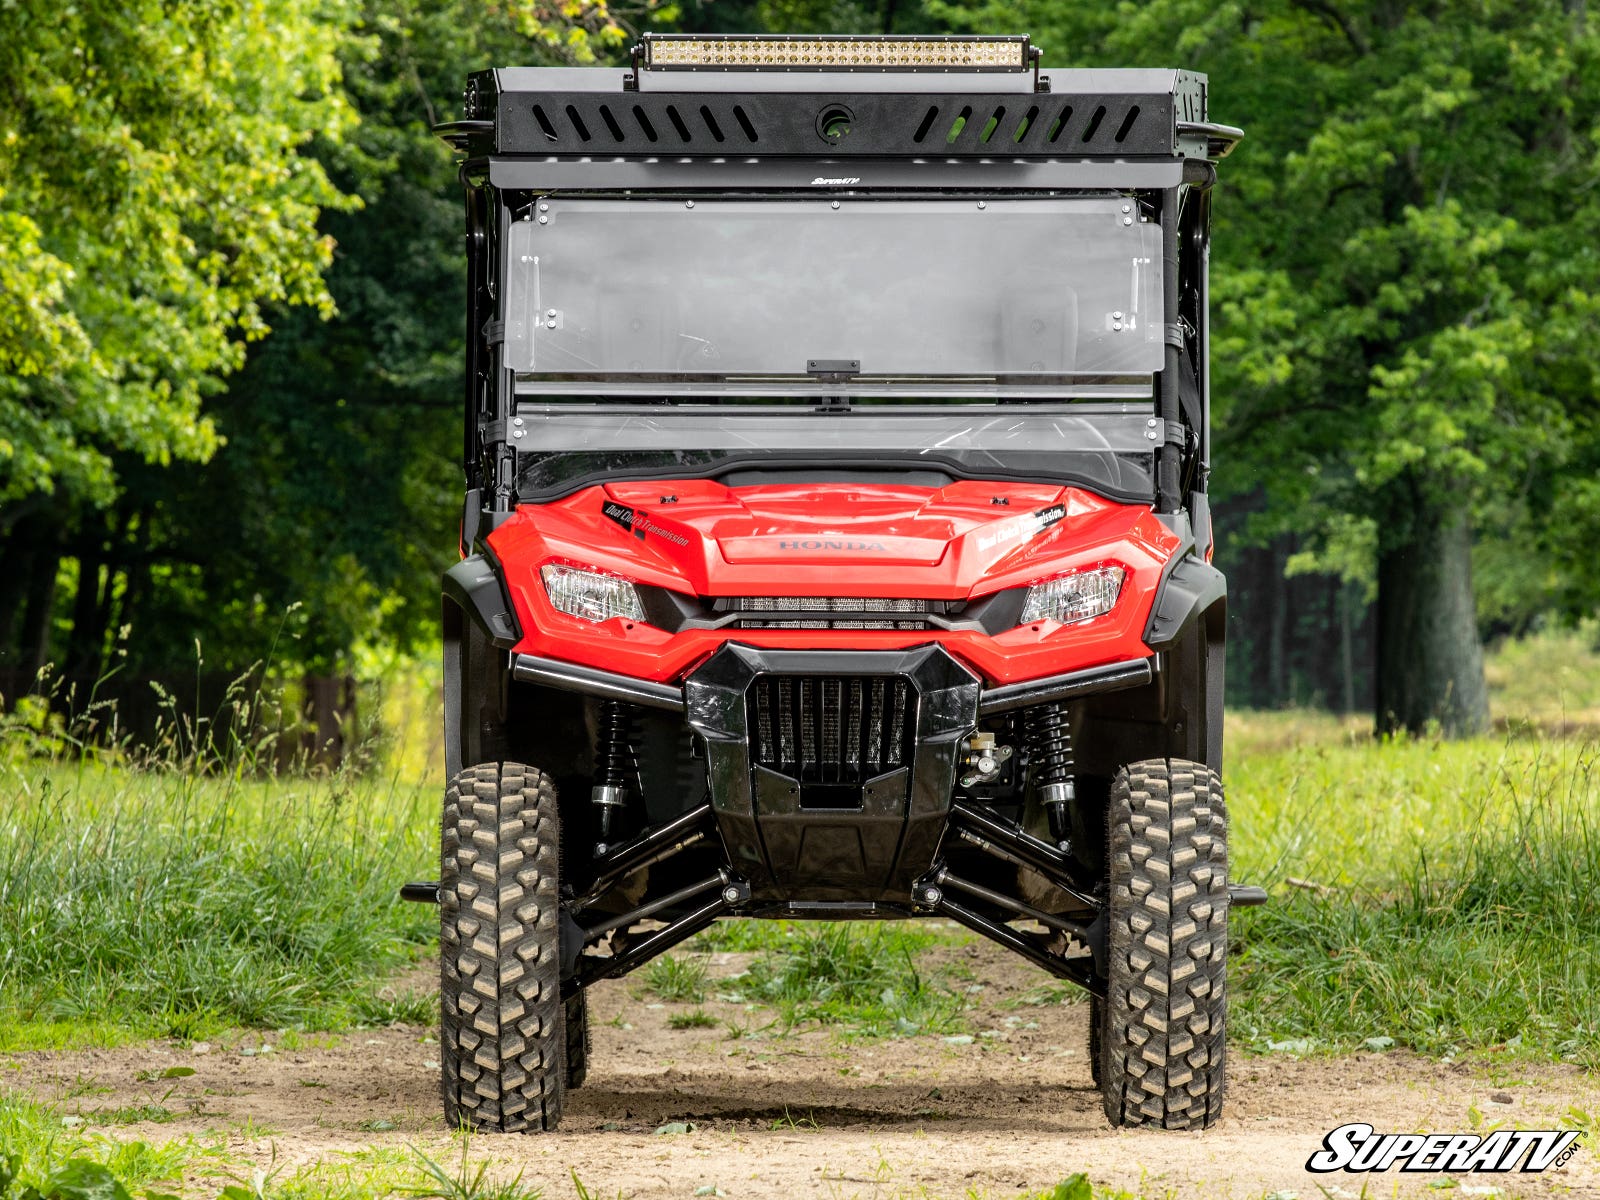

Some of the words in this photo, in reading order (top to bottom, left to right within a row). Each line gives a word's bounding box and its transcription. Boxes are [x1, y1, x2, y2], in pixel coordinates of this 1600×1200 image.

[604, 504, 622, 518] Dual
[620, 510, 643, 527] Clutch
[641, 519, 689, 547] Transmission
[1018, 508, 1062, 533] Tmission
[779, 541, 886, 551] HONDA
